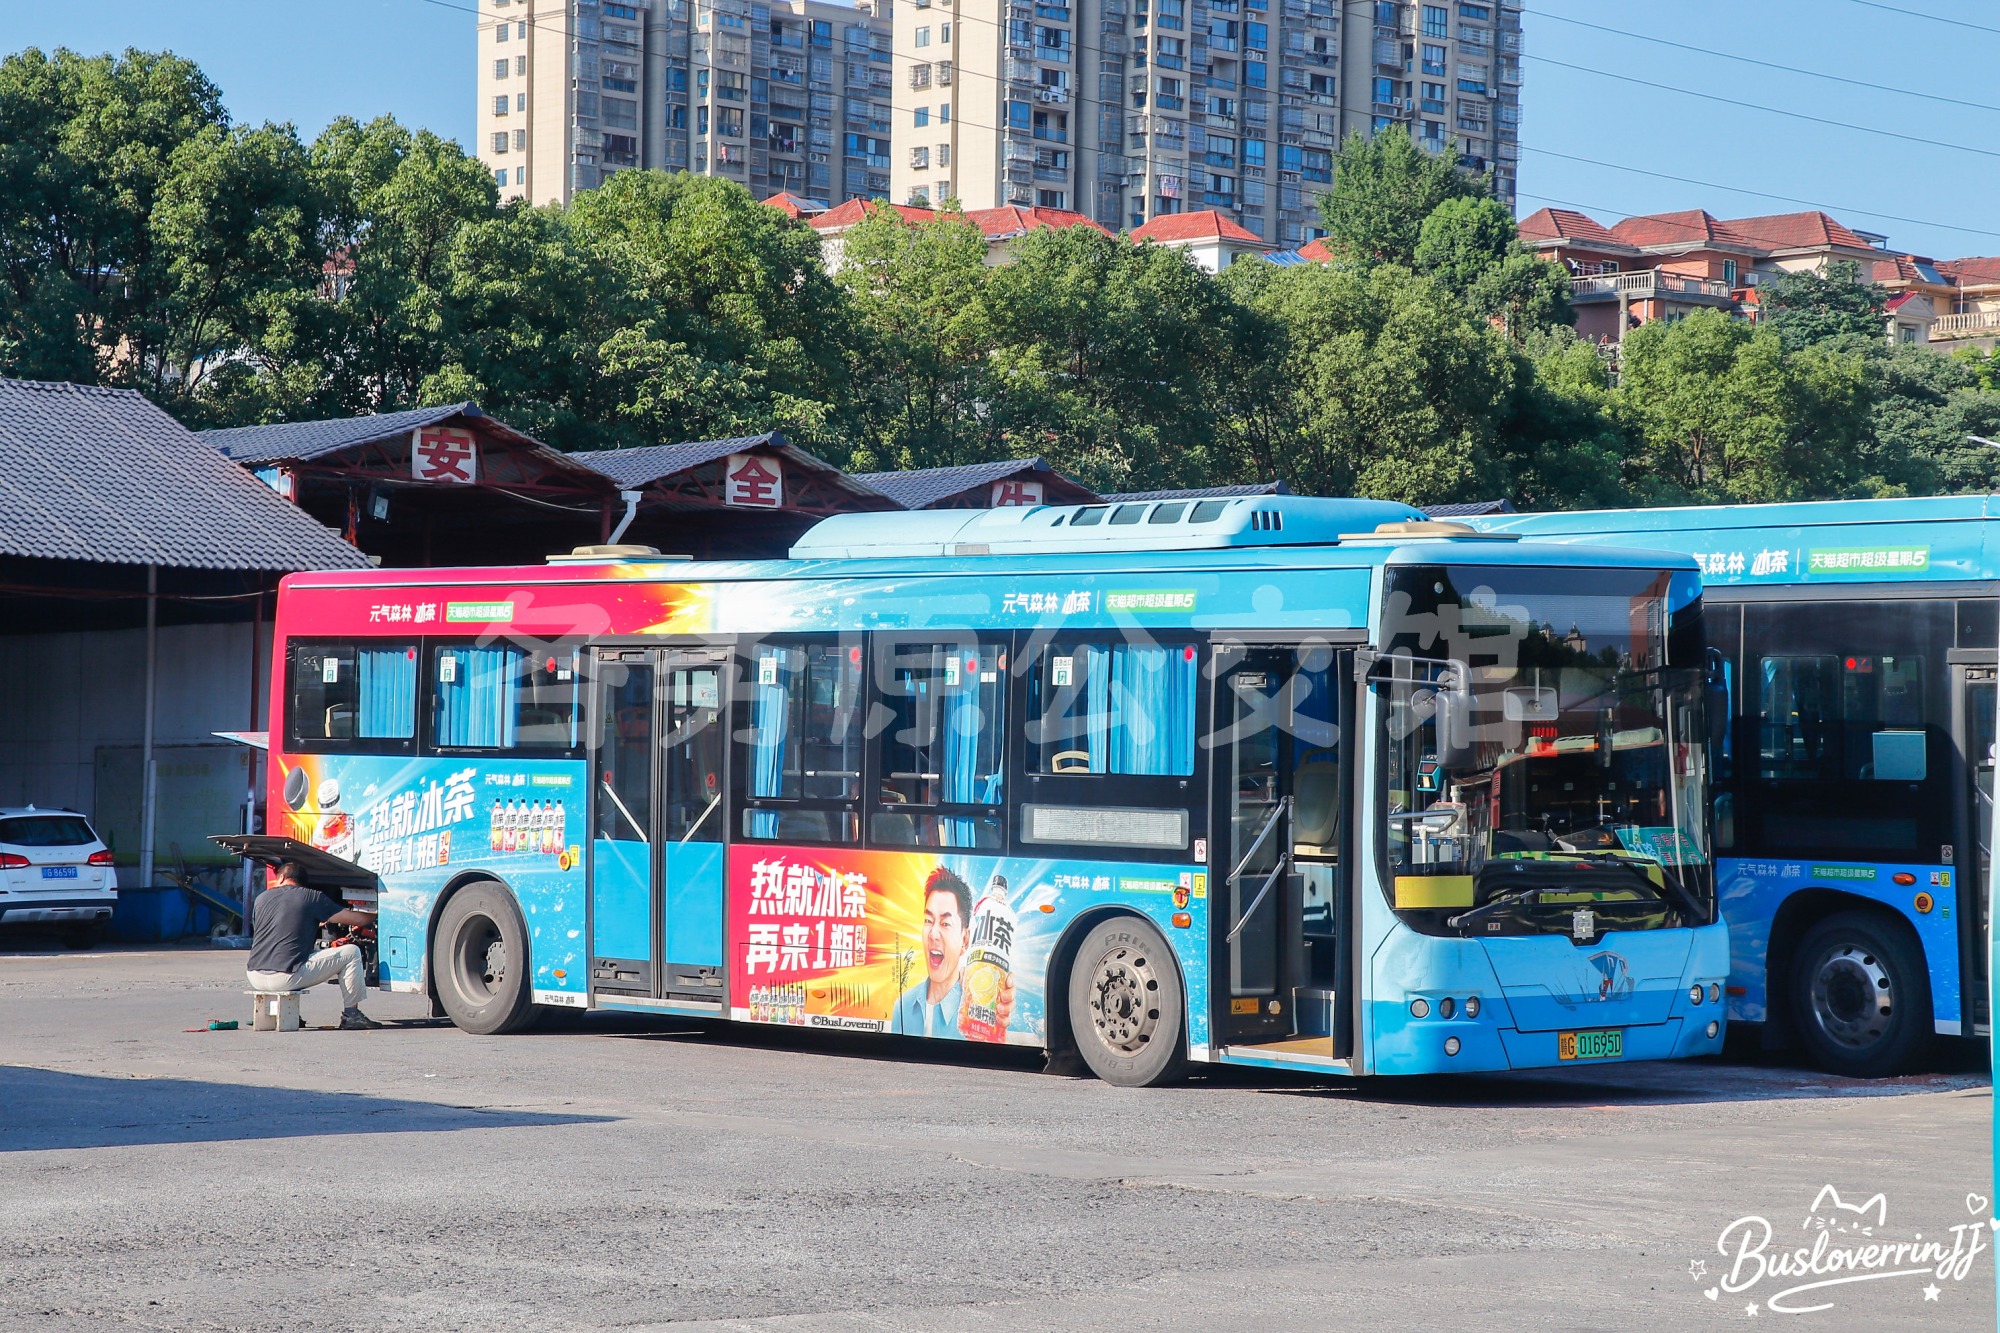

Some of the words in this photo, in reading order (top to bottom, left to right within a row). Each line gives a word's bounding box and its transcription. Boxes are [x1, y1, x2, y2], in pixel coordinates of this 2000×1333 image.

[418, 429, 471, 481] 安
[730, 457, 778, 505] 全
[1811, 550, 1927, 569] 天猫超市超级星期5
[370, 604, 412, 622] 元气森林
[1002, 593, 1058, 614] 元气森林
[1107, 593, 1195, 608] 天猫超市超级星期5
[369, 767, 477, 846] 热就冰茶
[368, 834, 439, 877] 再来1瓶
[748, 855, 868, 918] 热就冰茶
[746, 920, 855, 975] 再来1瓶
[971, 909, 1014, 956] 冰茶
[1579, 1033, 1622, 1055] 01695D
